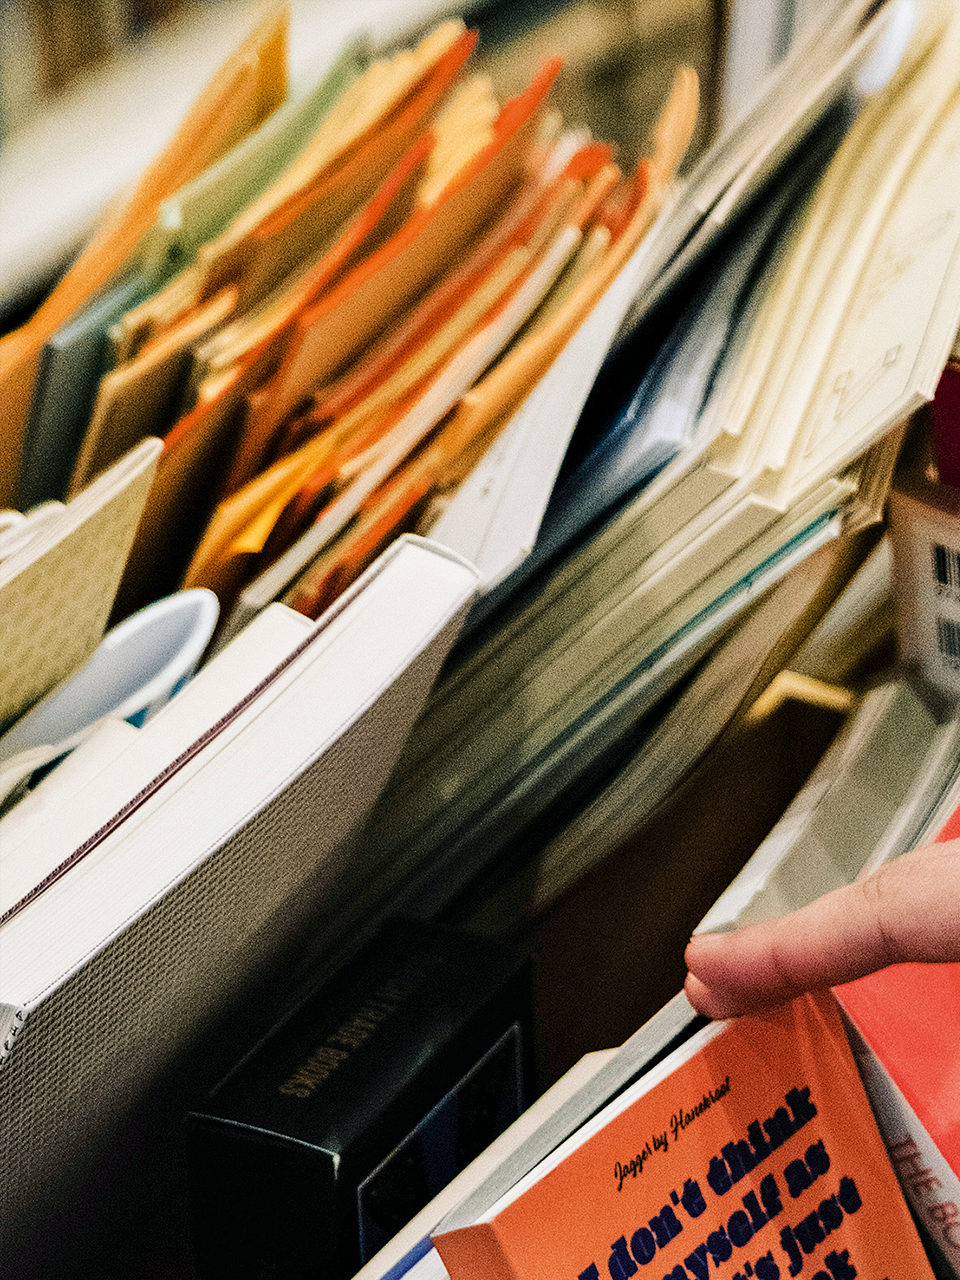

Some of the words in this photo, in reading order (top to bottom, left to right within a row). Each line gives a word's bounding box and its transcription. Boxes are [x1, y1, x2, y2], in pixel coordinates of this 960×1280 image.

[277, 1045, 349, 1099] BOOKS
[615, 1142, 652, 1190] Jagger
[652, 1131, 668, 1152] by
[706, 1086, 818, 1196] think
[783, 1139, 831, 1198] as
[885, 1134, 942, 1196] THE
[780, 1176, 862, 1277] just
